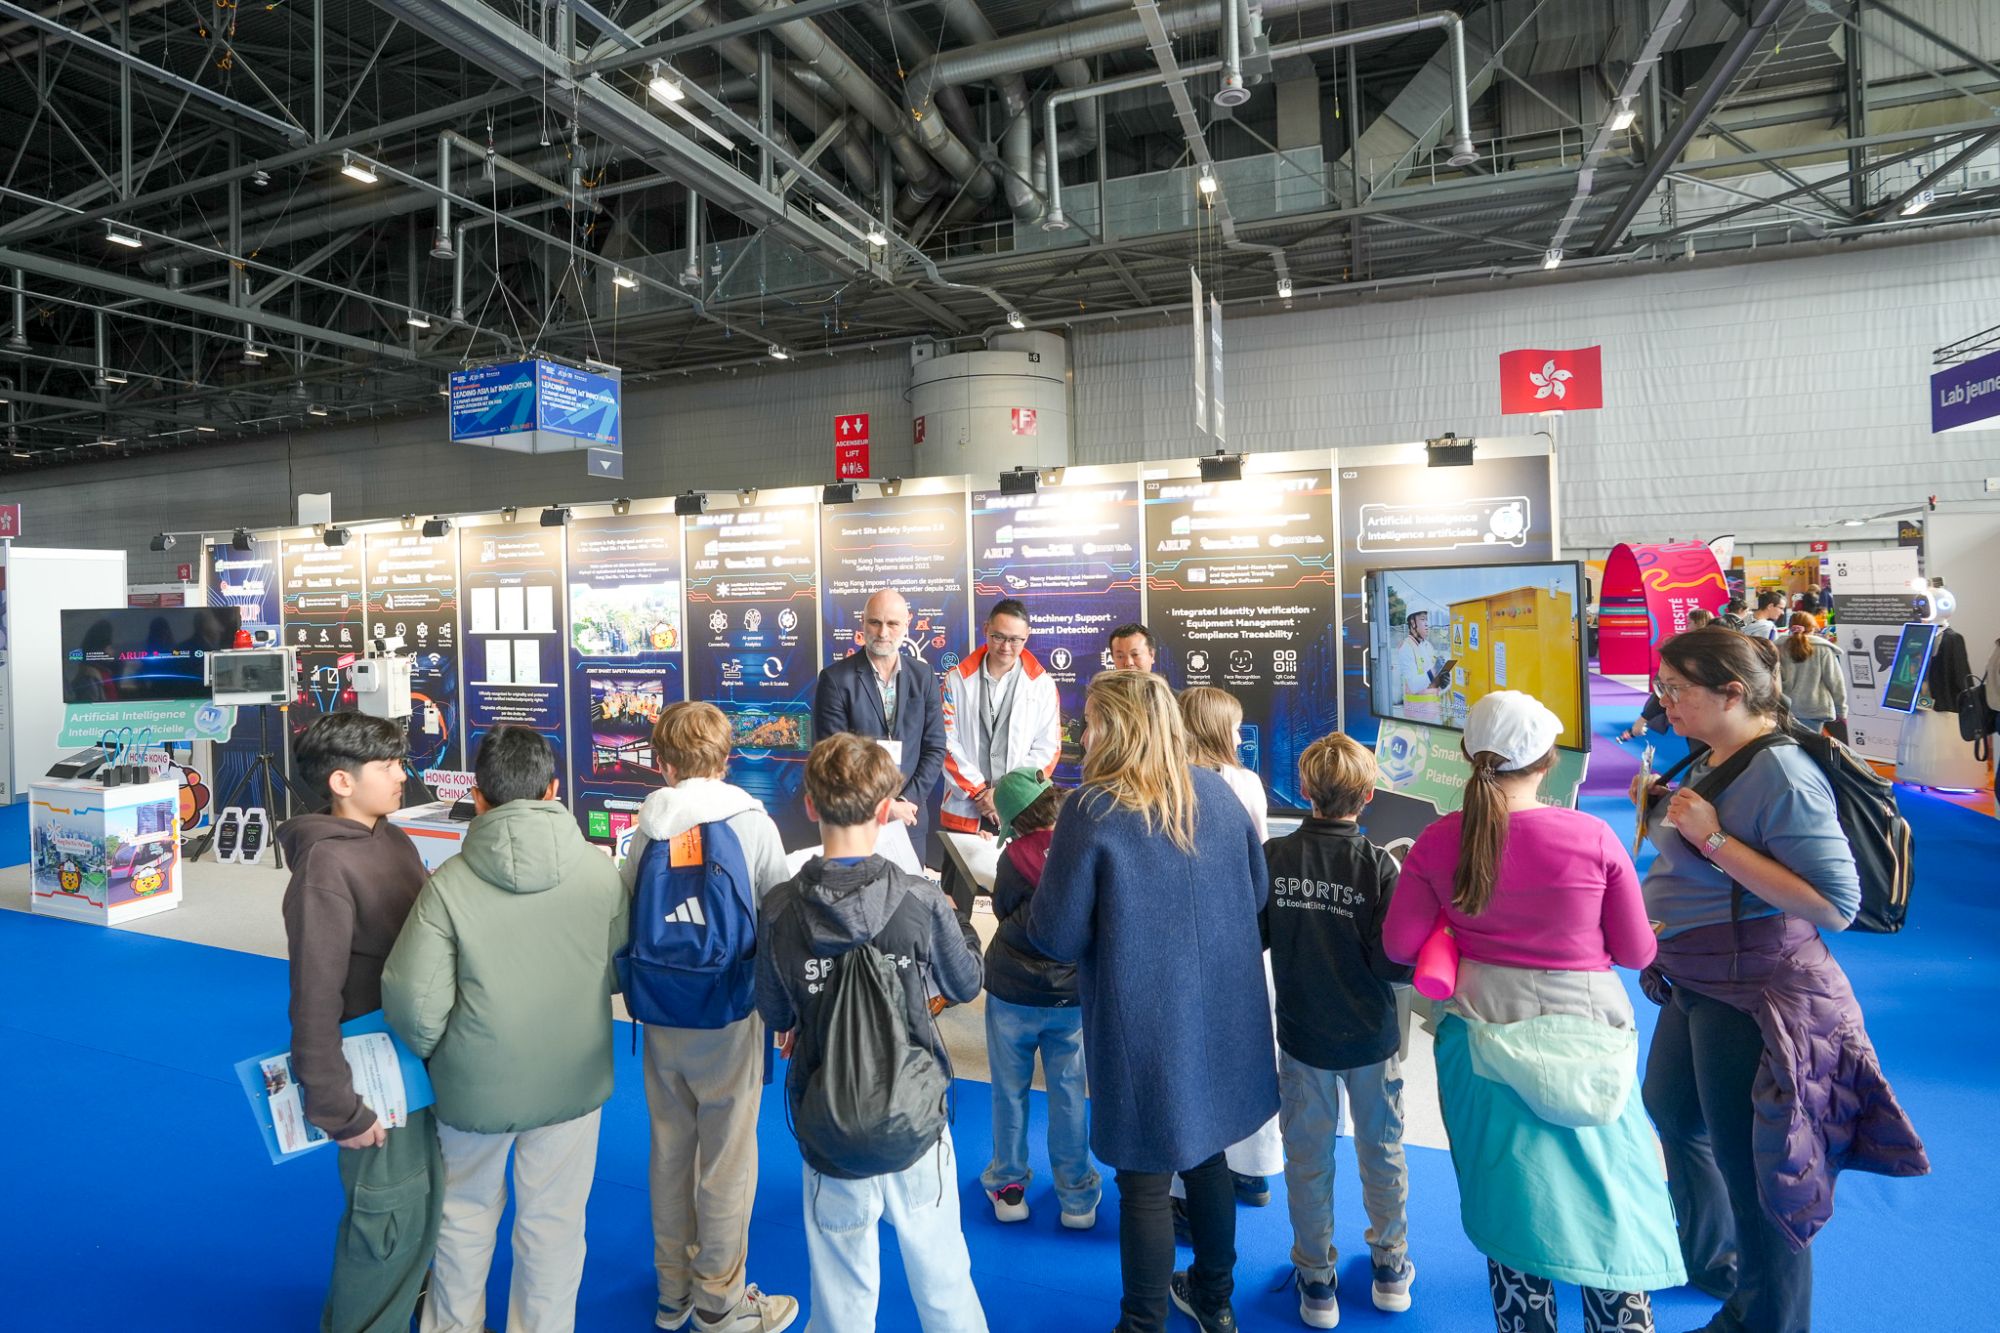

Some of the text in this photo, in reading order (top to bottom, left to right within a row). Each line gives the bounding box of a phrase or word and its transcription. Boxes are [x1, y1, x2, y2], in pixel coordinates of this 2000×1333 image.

[1547, 249, 1561, 259] 17
[1278, 279, 1291, 290] 16
[453, 389, 476, 399] LEADING
[477, 387, 489, 396] ASIA
[541, 380, 565, 392] LEADING
[566, 386, 577, 395] ASIA
[1940, 384, 1964, 407] Lab
[1019, 409, 1032, 429] F
[915, 418, 923, 433] F
[835, 438, 869, 447] ASCENSEUR
[845, 449, 859, 457] LIFT
[1367, 513, 1478, 527] Artificial Intelligence
[878, 526, 900, 535] Safety
[1367, 529, 1478, 542] Intelligence artificielle
[1157, 539, 1192, 551] ARUP
[983, 547, 1014, 559] ARUP
[842, 557, 857, 566] Hong
[858, 556, 873, 566] Kong
[856, 564, 874, 573] Safety
[875, 564, 898, 573] Systems
[833, 580, 848, 589] Hong
[850, 580, 865, 588] Kong
[866, 579, 886, 588] impose
[887, 578, 918, 586] l'utilisation
[829, 587, 859, 595] intelligents
[900, 585, 923, 593] chantier
[924, 585, 943, 593] depuis
[945, 584, 962, 592] 2023.
[1171, 606, 1310, 618] Integrated Identity Verification
[1029, 613, 1111, 625] Machinery Support
[1186, 618, 1295, 630] Equipment Management
[1057, 625, 1099, 634] Detection
[1188, 630, 1293, 641] Compliance Traceability
[119, 651, 147, 660] ARUP
[71, 710, 215, 722] Artificial Intelligence AI
[1392, 744, 1401, 754] AI
[129, 752, 168, 763] HONG KONG
[425, 772, 451, 784] HONG
[438, 787, 465, 798] CHINA
[1274, 877, 1365, 905] SPORTS+
